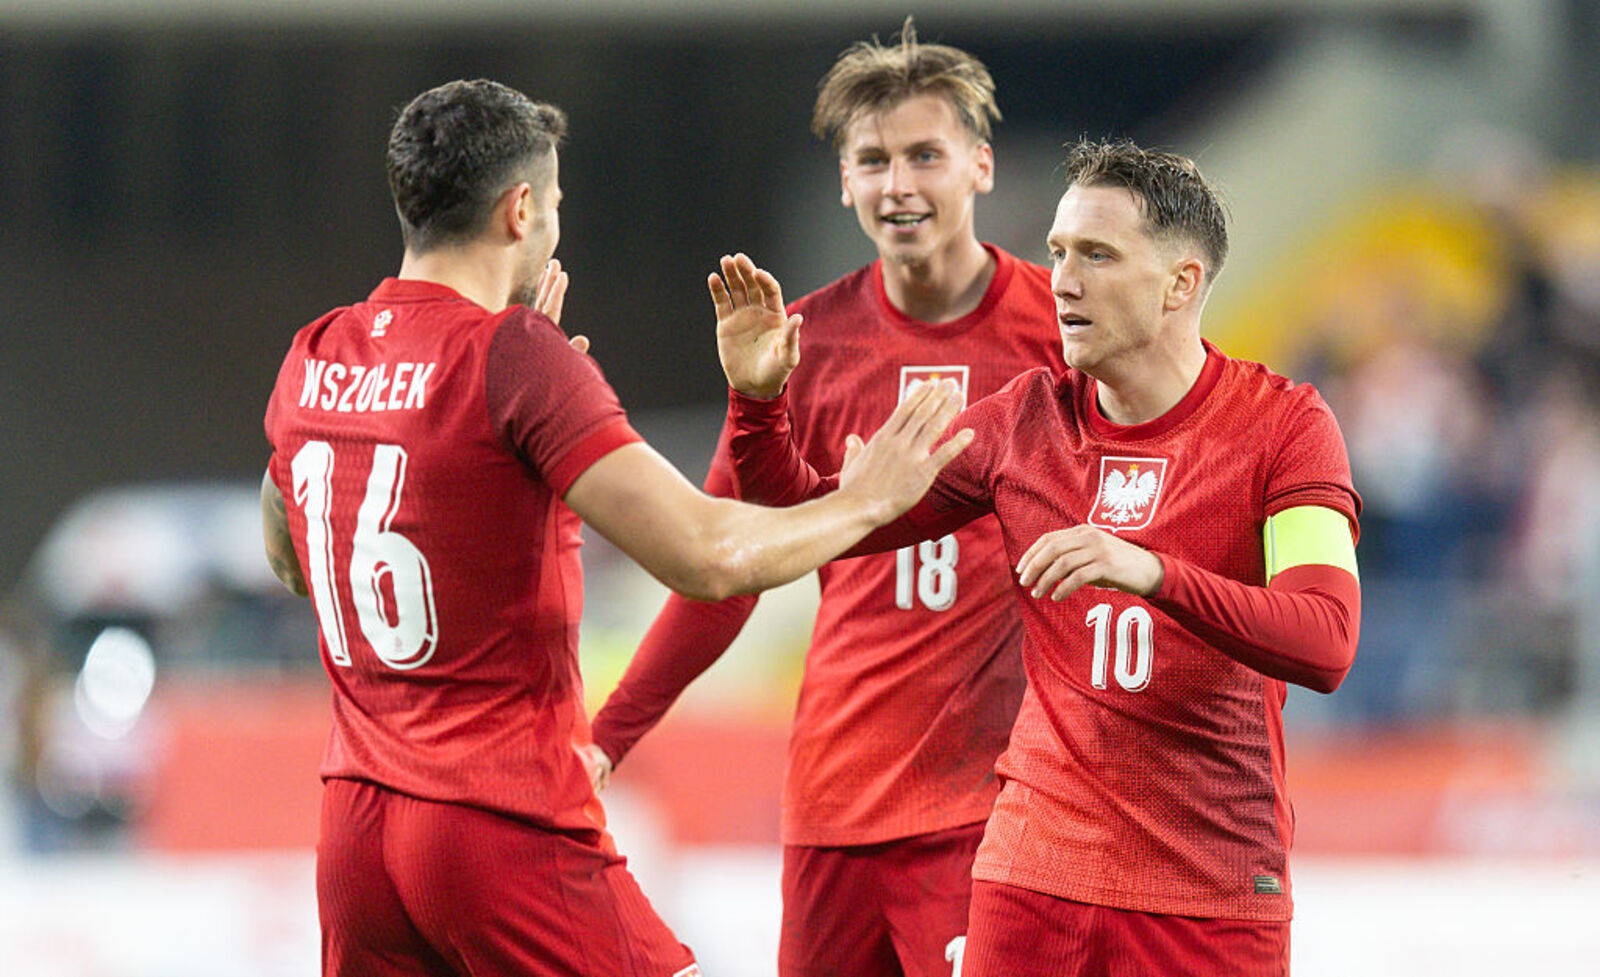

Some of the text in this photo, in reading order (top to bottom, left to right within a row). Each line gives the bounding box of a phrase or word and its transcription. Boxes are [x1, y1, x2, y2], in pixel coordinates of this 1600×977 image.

[299, 358, 436, 413] WSZOŁEK
[291, 440, 438, 670] 16
[896, 533, 959, 612] 18
[1086, 603, 1154, 692] 10
